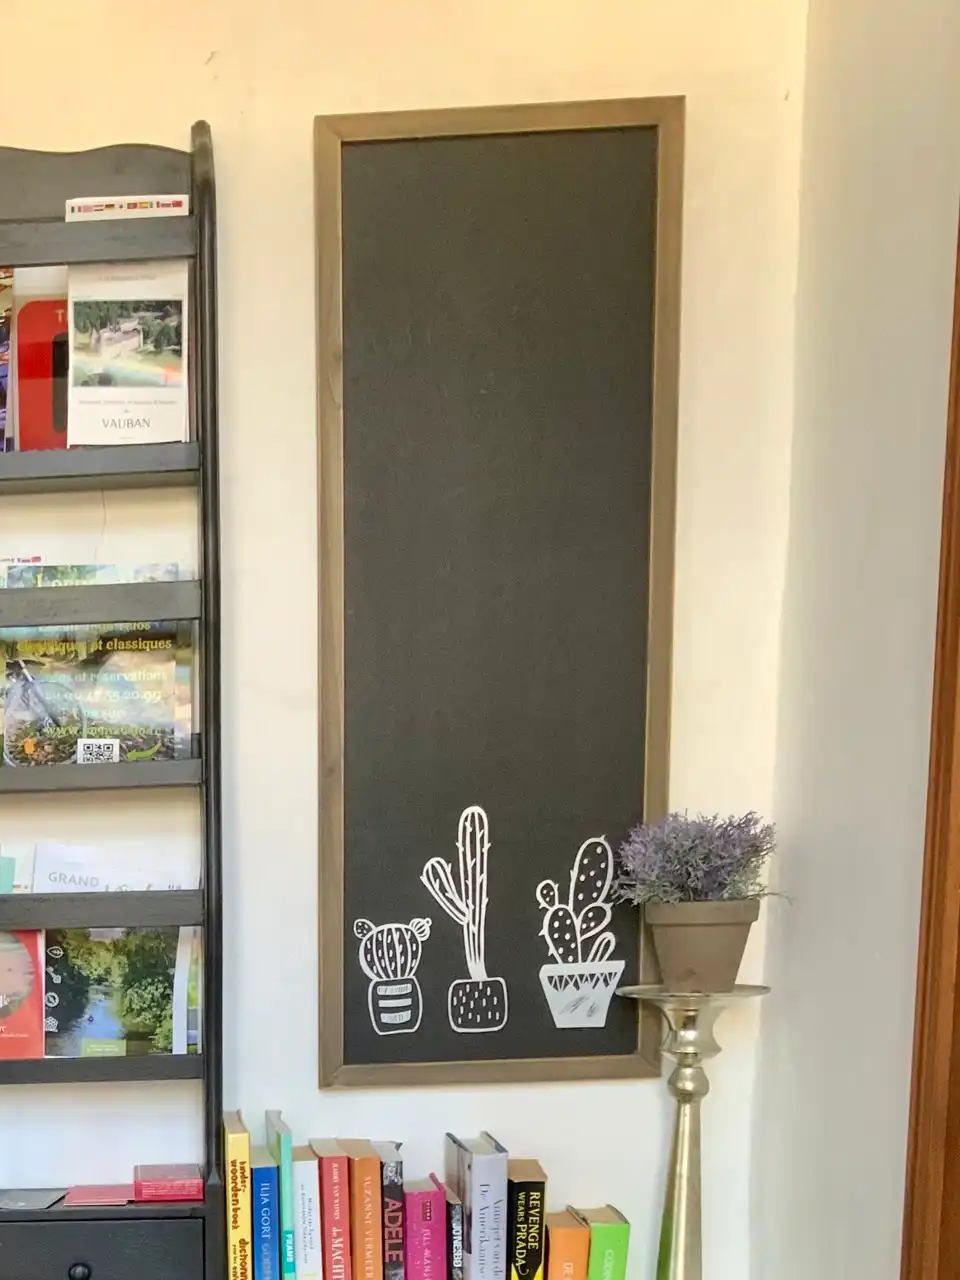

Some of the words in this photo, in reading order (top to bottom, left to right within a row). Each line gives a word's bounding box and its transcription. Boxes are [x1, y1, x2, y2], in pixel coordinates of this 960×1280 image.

[102, 418, 151, 429] VAUBAN
[106, 638, 172, 655] classiques
[48, 872, 99, 888] GRAND
[259, 1182, 271, 1205] ILJA
[517, 1192, 526, 1222] WEARS
[260, 1207, 272, 1239] GORT
[332, 1227, 341, 1237] de
[385, 1198, 403, 1263] ADELE
[528, 1192, 541, 1250] REVENGE
[285, 1234, 295, 1263] FRANS
[364, 1230, 374, 1280] VERMEER
[479, 1203, 490, 1278] Amerikaanse
[493, 1244, 501, 1264] van
[515, 1223, 530, 1275] PRADA
[331, 1237, 345, 1280] MACHT
[563, 1262, 574, 1275] DE
